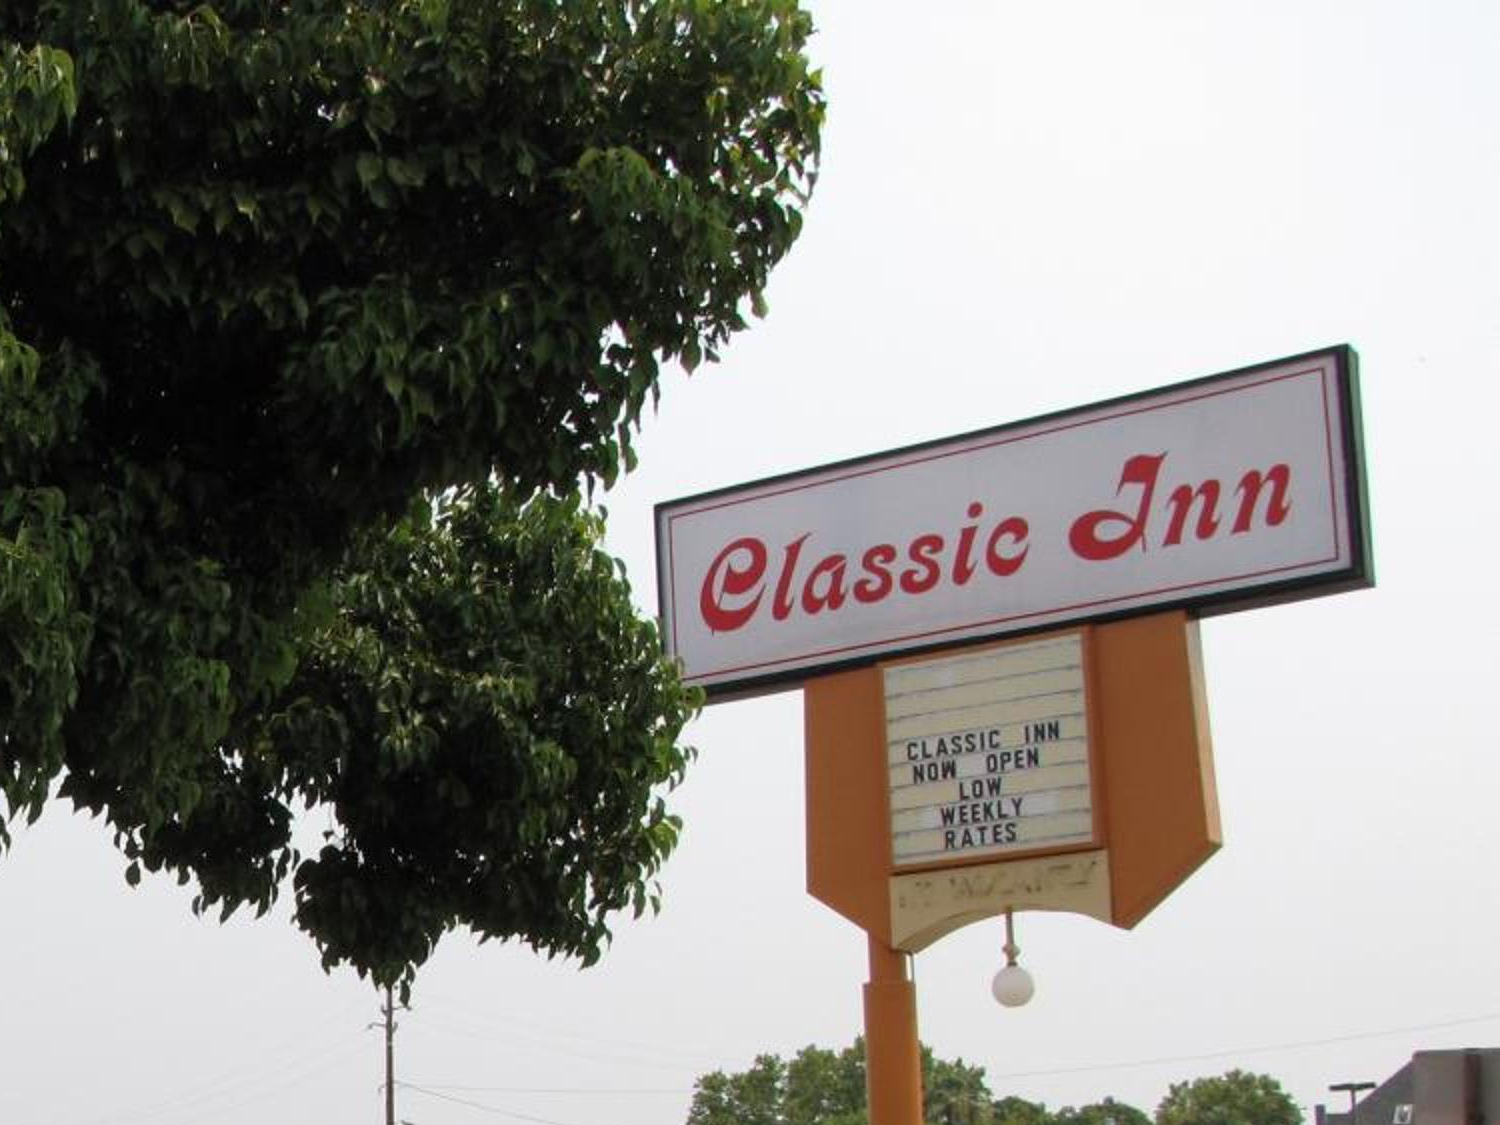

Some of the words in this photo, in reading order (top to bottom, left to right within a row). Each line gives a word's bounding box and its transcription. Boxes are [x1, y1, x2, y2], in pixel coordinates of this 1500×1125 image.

[699, 501, 1029, 636] Classic
[1068, 451, 1293, 562] Inn
[907, 729, 1001, 761] CLASSIC
[1024, 720, 1060, 745] INN
[913, 760, 957, 784] NOW
[986, 747, 1040, 774] OPEN
[959, 776, 1002, 801] LOW
[940, 798, 1023, 826] WEEKLY
[945, 822, 1017, 849] RATES
